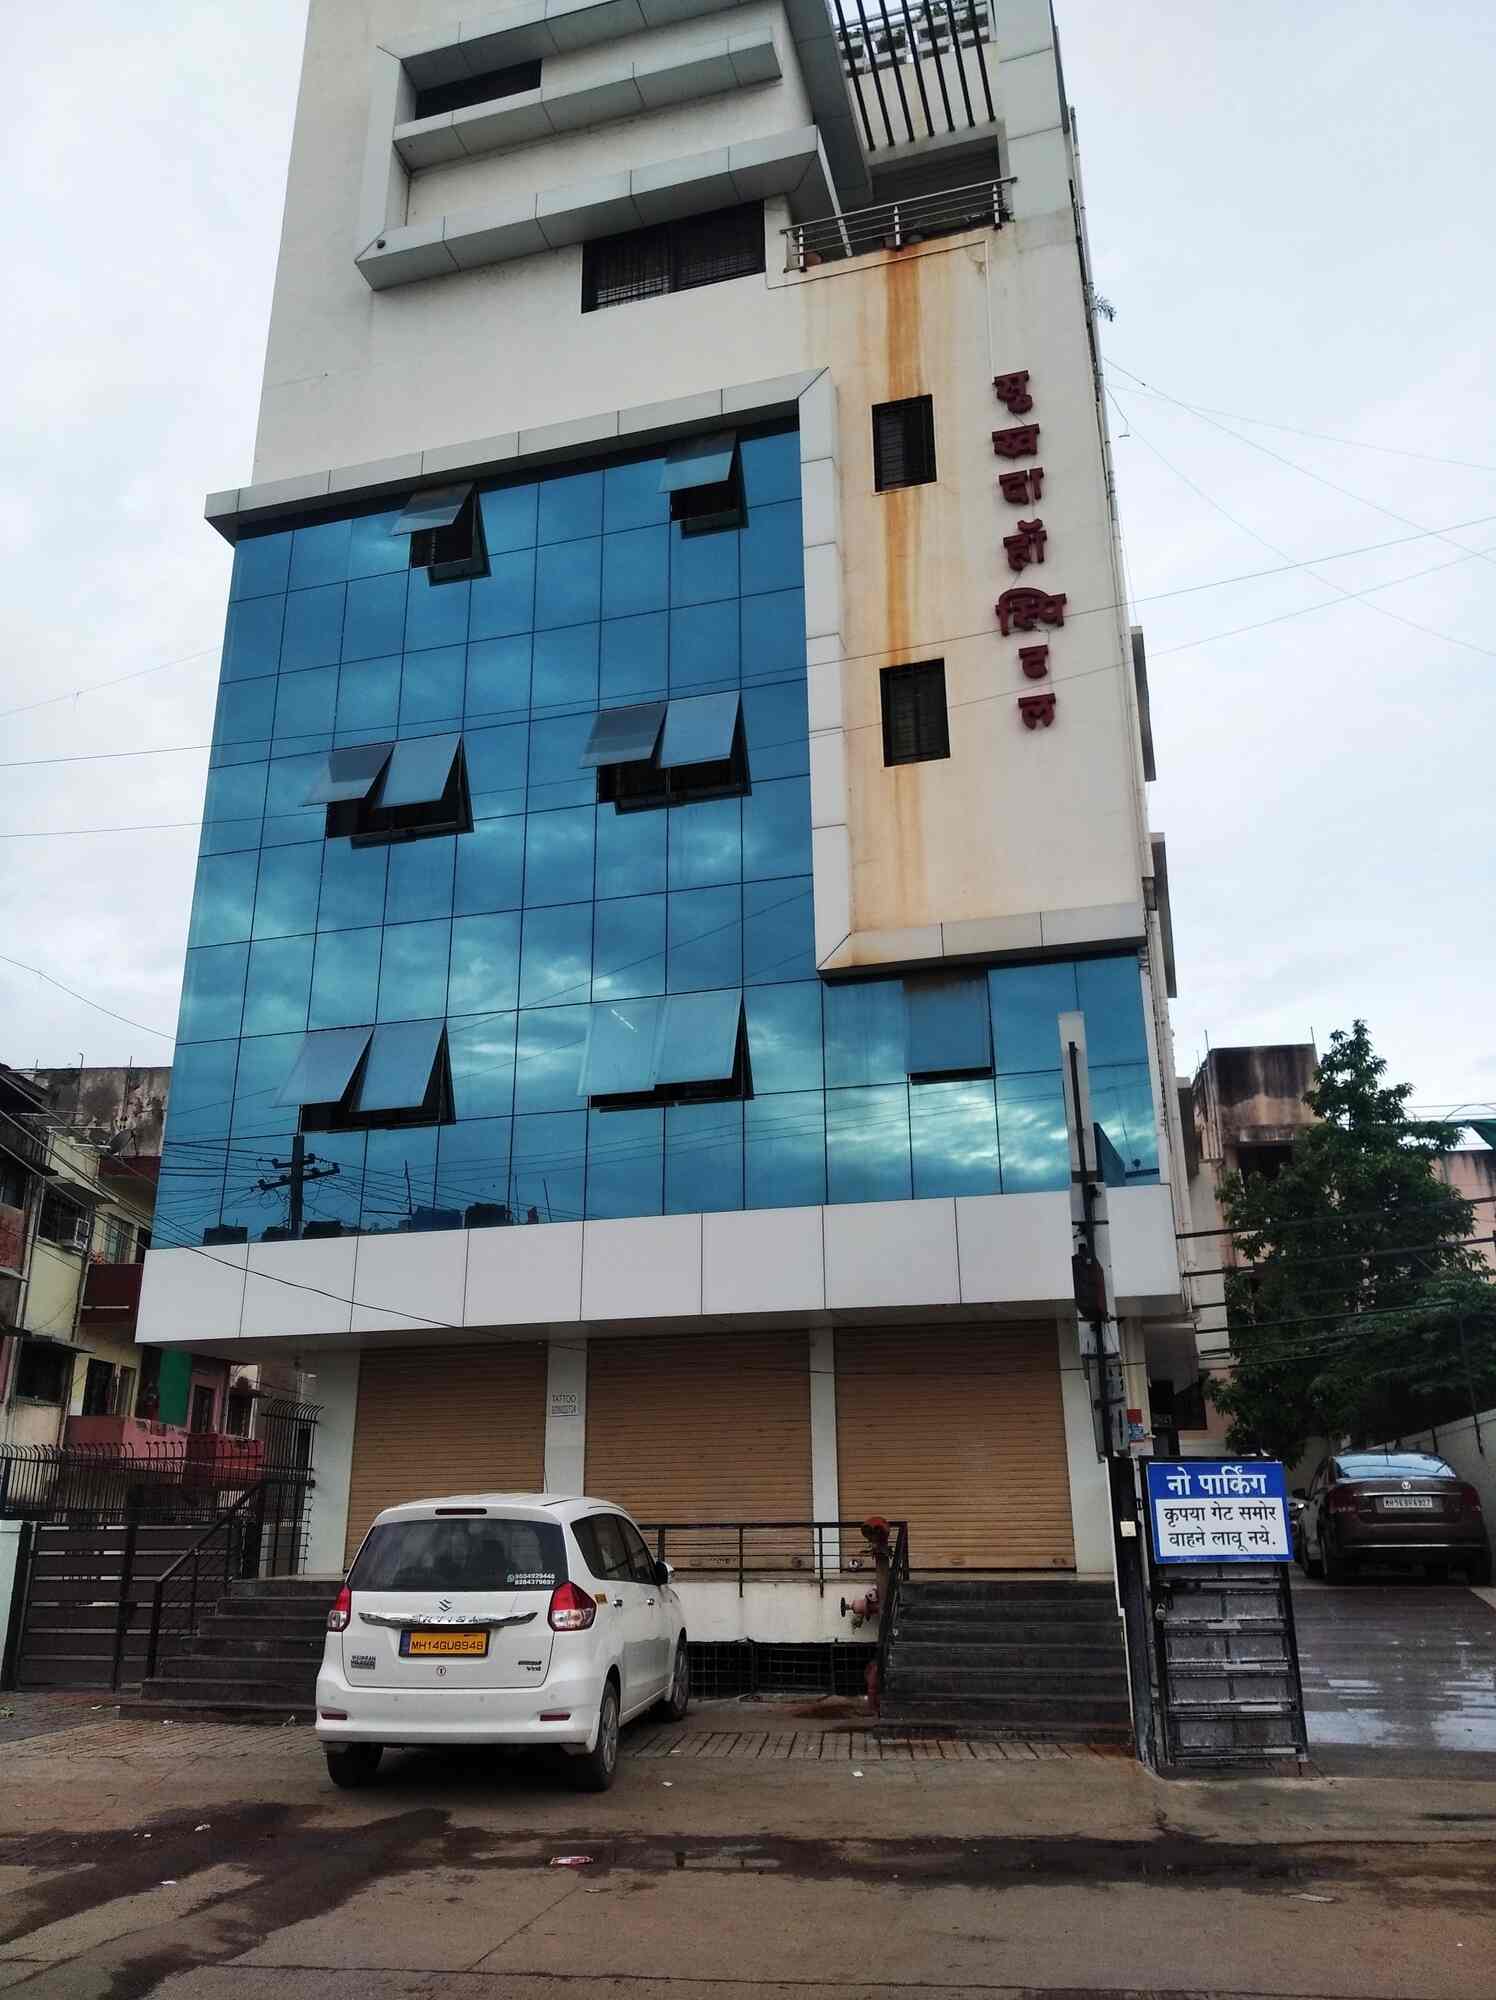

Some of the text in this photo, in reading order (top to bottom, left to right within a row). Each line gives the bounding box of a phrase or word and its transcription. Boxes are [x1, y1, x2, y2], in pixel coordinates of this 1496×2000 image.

[995, 518, 1067, 729] हॉस्पिटल
[1166, 1465, 1267, 1495] नो पार्किंग
[1164, 1501, 1276, 1527] कृपया गेट समोर
[1168, 1526, 1206, 1547] वाहने
[1211, 1531, 1247, 1552] लावू
